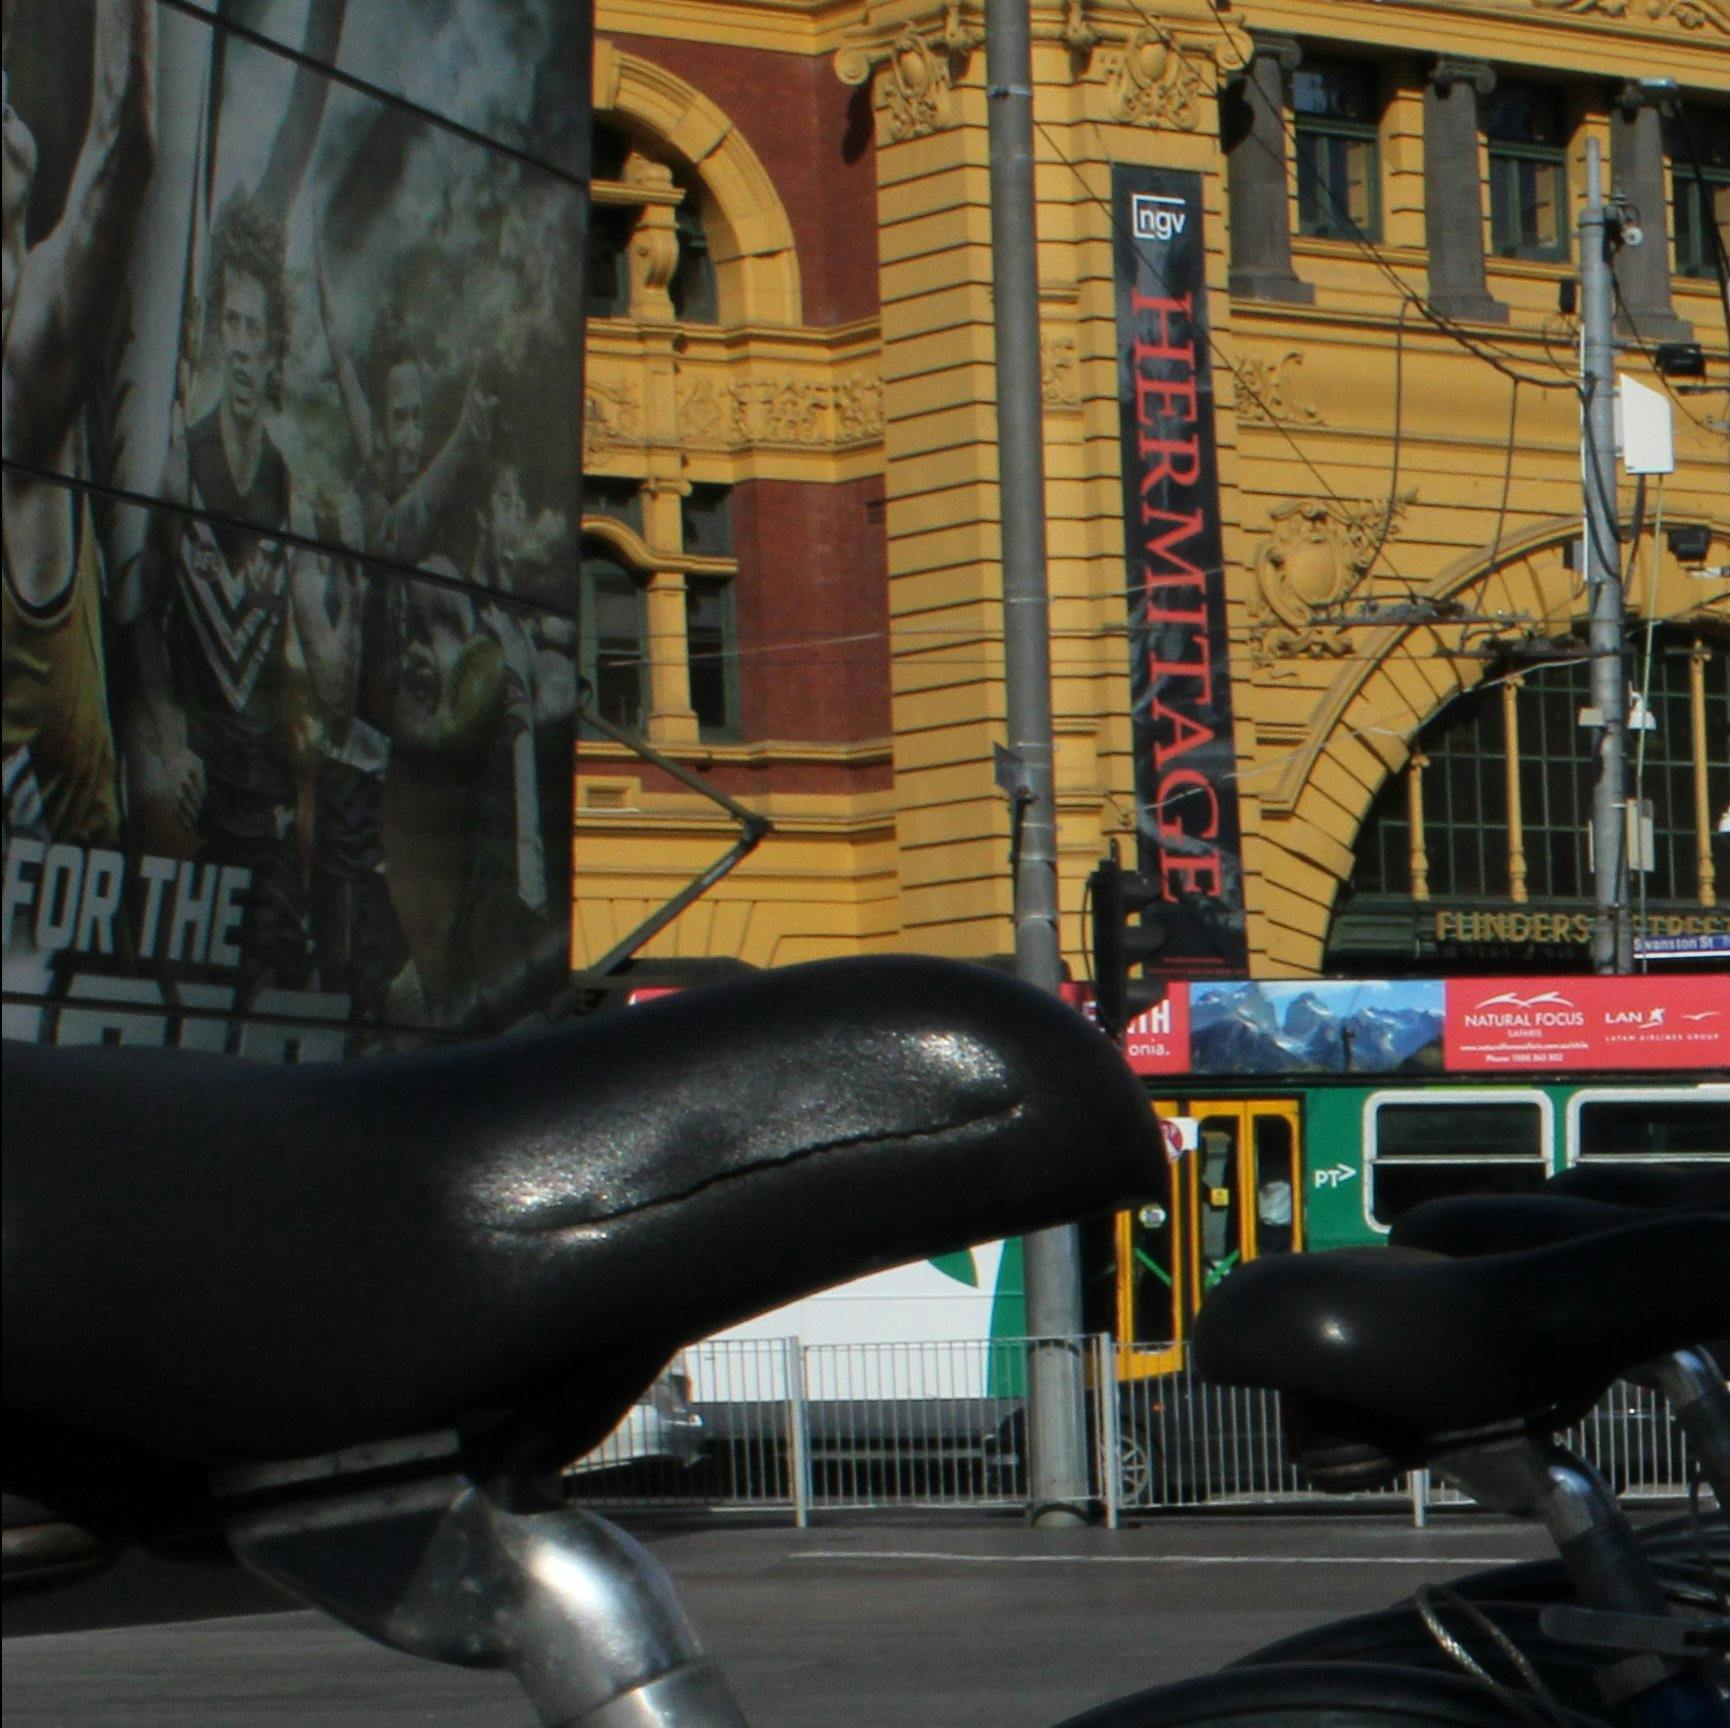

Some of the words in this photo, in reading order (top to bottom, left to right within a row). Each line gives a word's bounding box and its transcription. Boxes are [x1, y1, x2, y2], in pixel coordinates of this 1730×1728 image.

[1140, 205, 1186, 238] ngv
[1132, 293, 1222, 902] HERMITAGE
[3, 837, 127, 955] FOR
[139, 856, 252, 967] THE
[1436, 911, 1591, 943] FLINDERS
[1632, 936, 1698, 952] Swanston
[1465, 1013, 1531, 1028] NATURAL
[1536, 1012, 1584, 1027] FOCUS
[1605, 1011, 1643, 1024] LAN
[1507, 1029, 1543, 1038] SAFARIS
